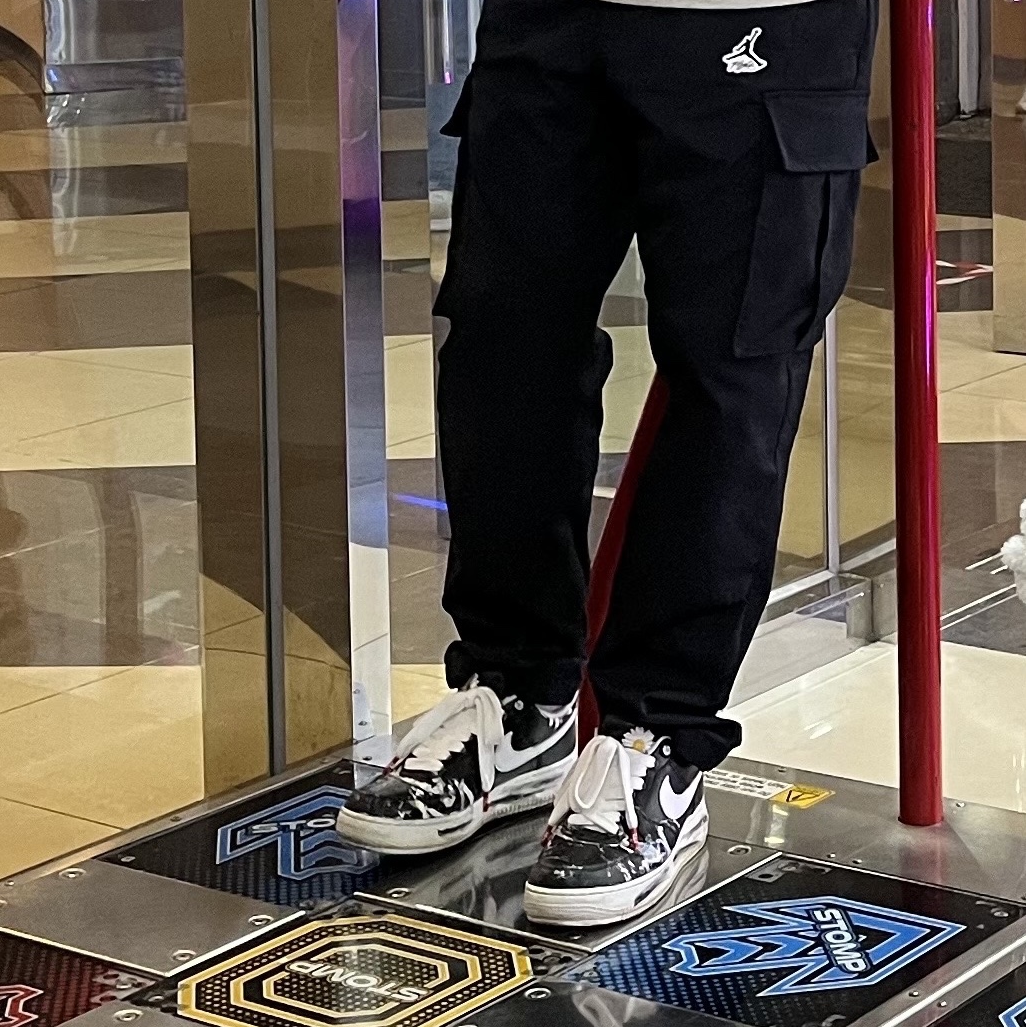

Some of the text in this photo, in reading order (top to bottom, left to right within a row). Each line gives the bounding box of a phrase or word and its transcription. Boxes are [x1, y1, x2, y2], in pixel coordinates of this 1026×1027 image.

[252, 818, 336, 834] STO
[815, 908, 867, 972] STOMP
[288, 960, 429, 1002] STOMP
